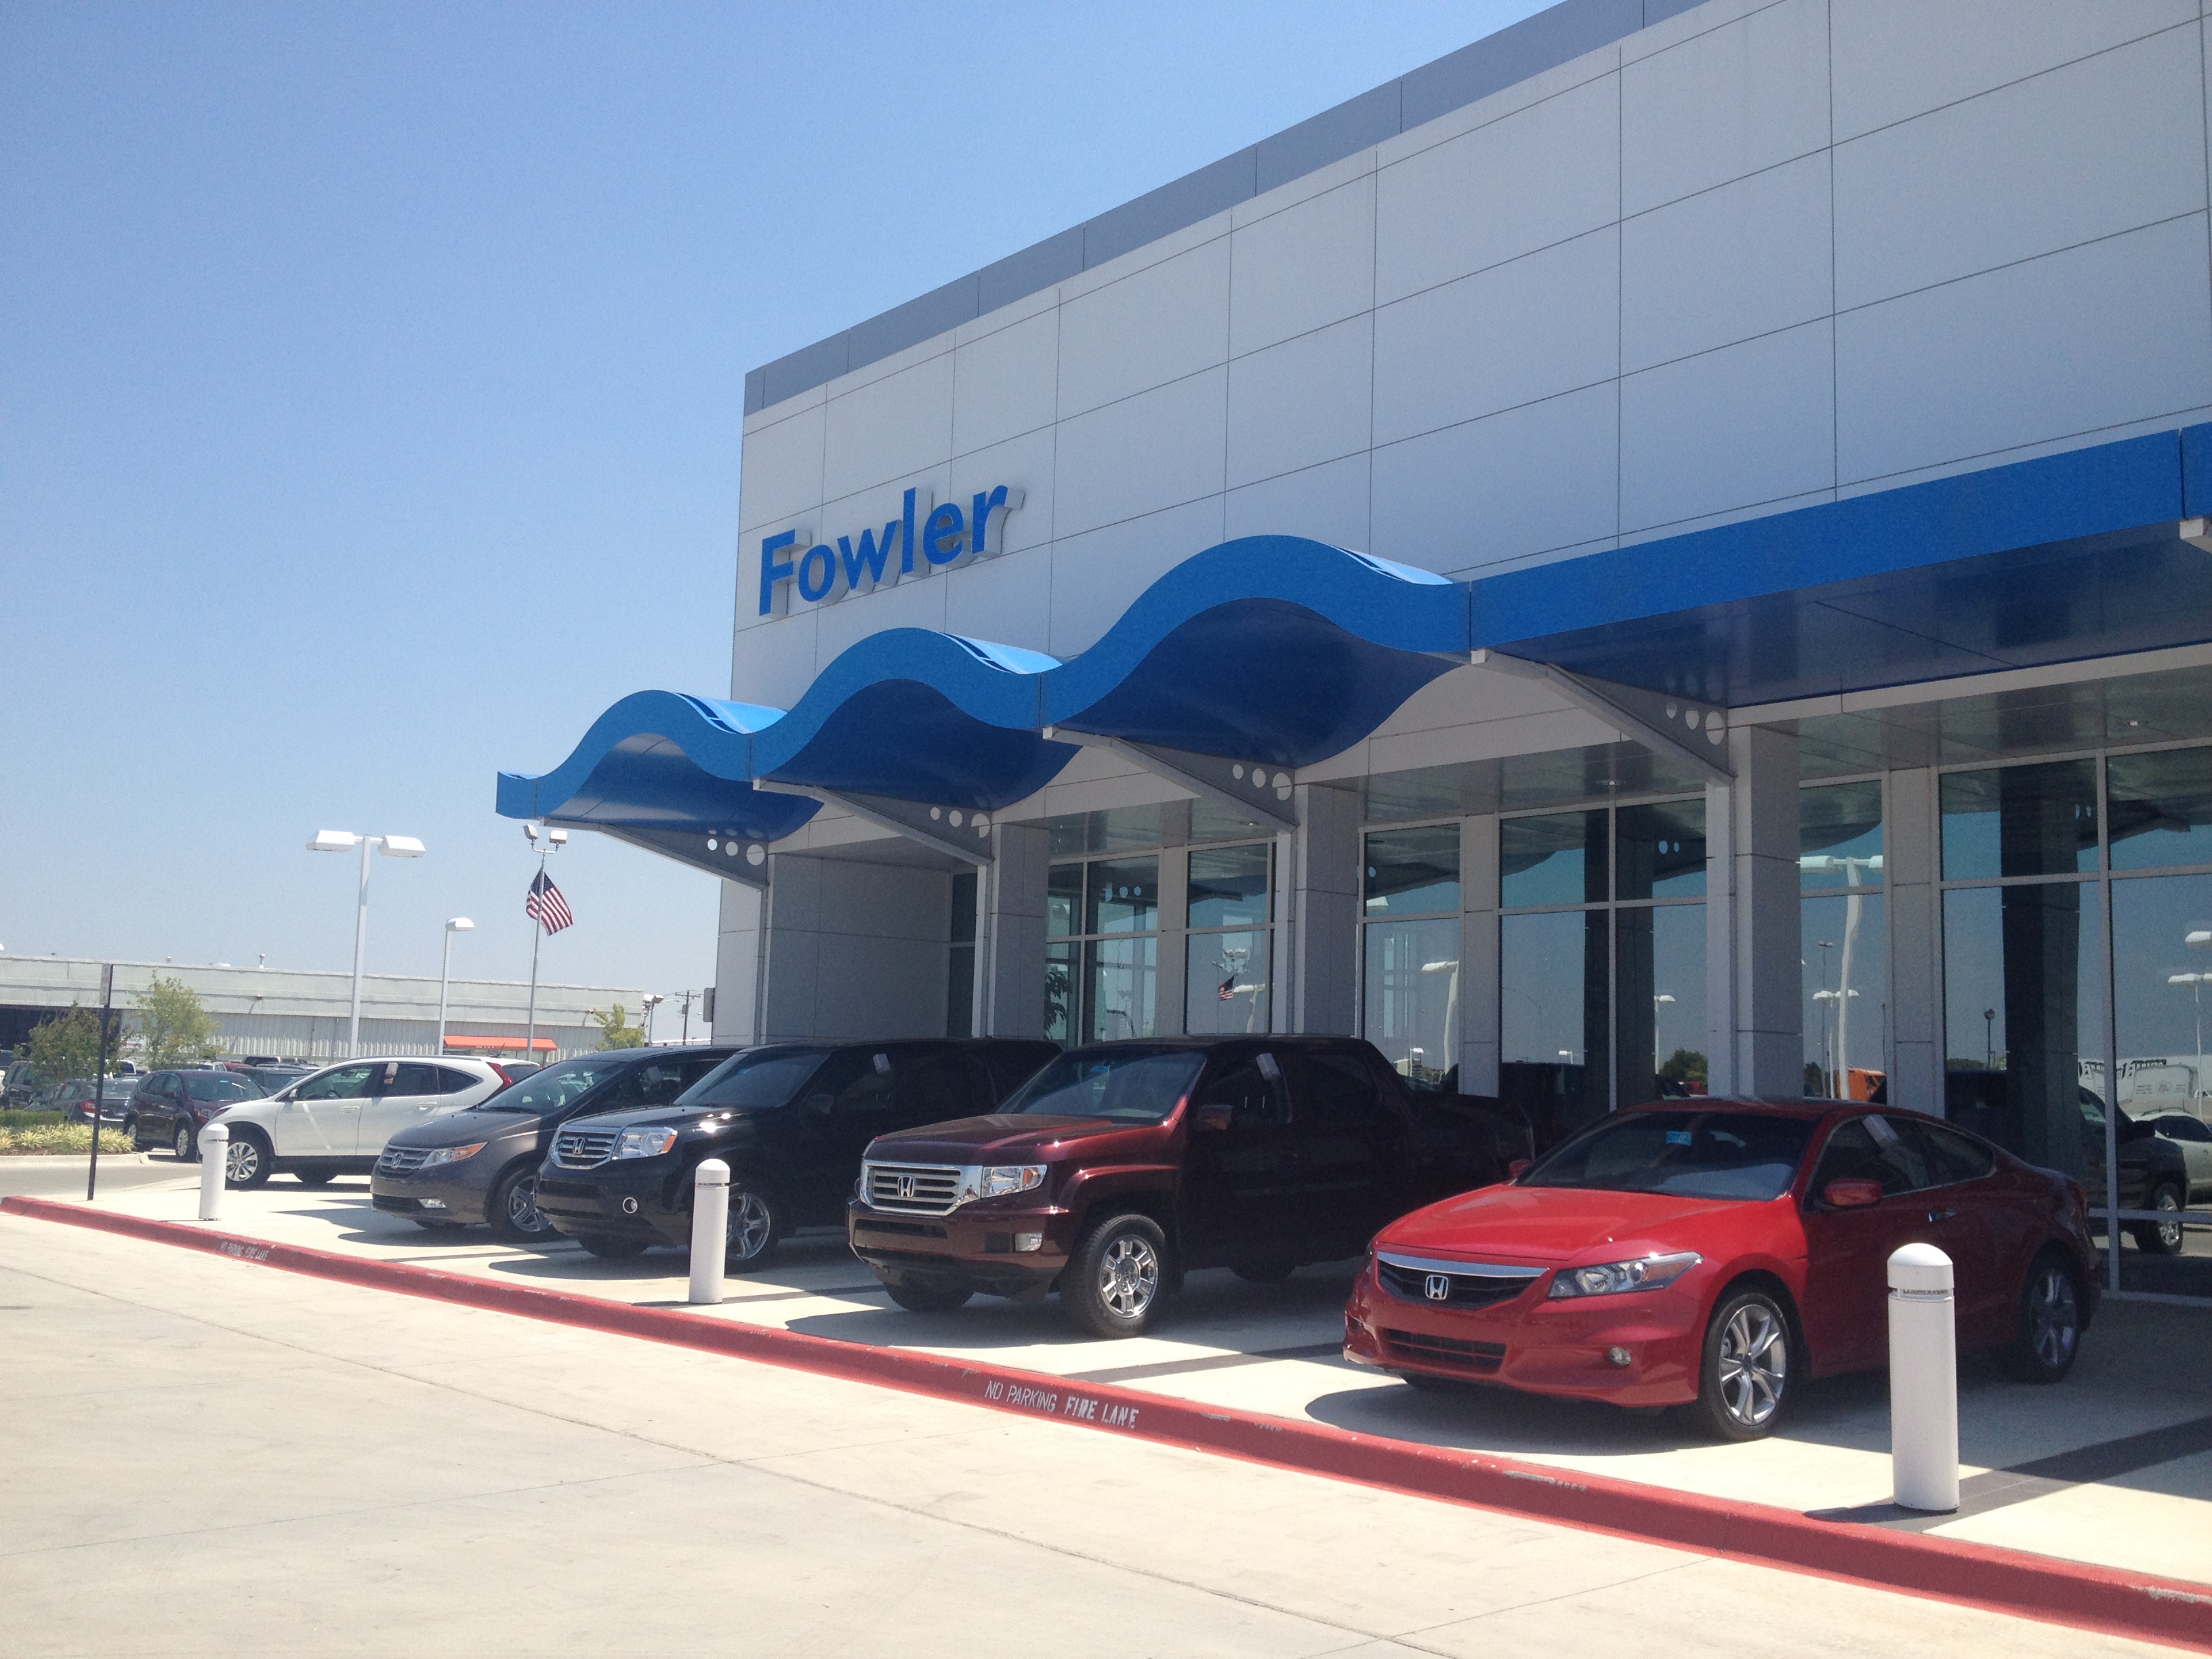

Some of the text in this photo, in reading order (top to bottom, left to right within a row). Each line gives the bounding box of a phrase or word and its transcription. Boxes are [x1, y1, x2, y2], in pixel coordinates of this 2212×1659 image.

[759, 485, 1011, 617] Fowler
[985, 1380, 1139, 1429] NO PARKING FIRE LANE
